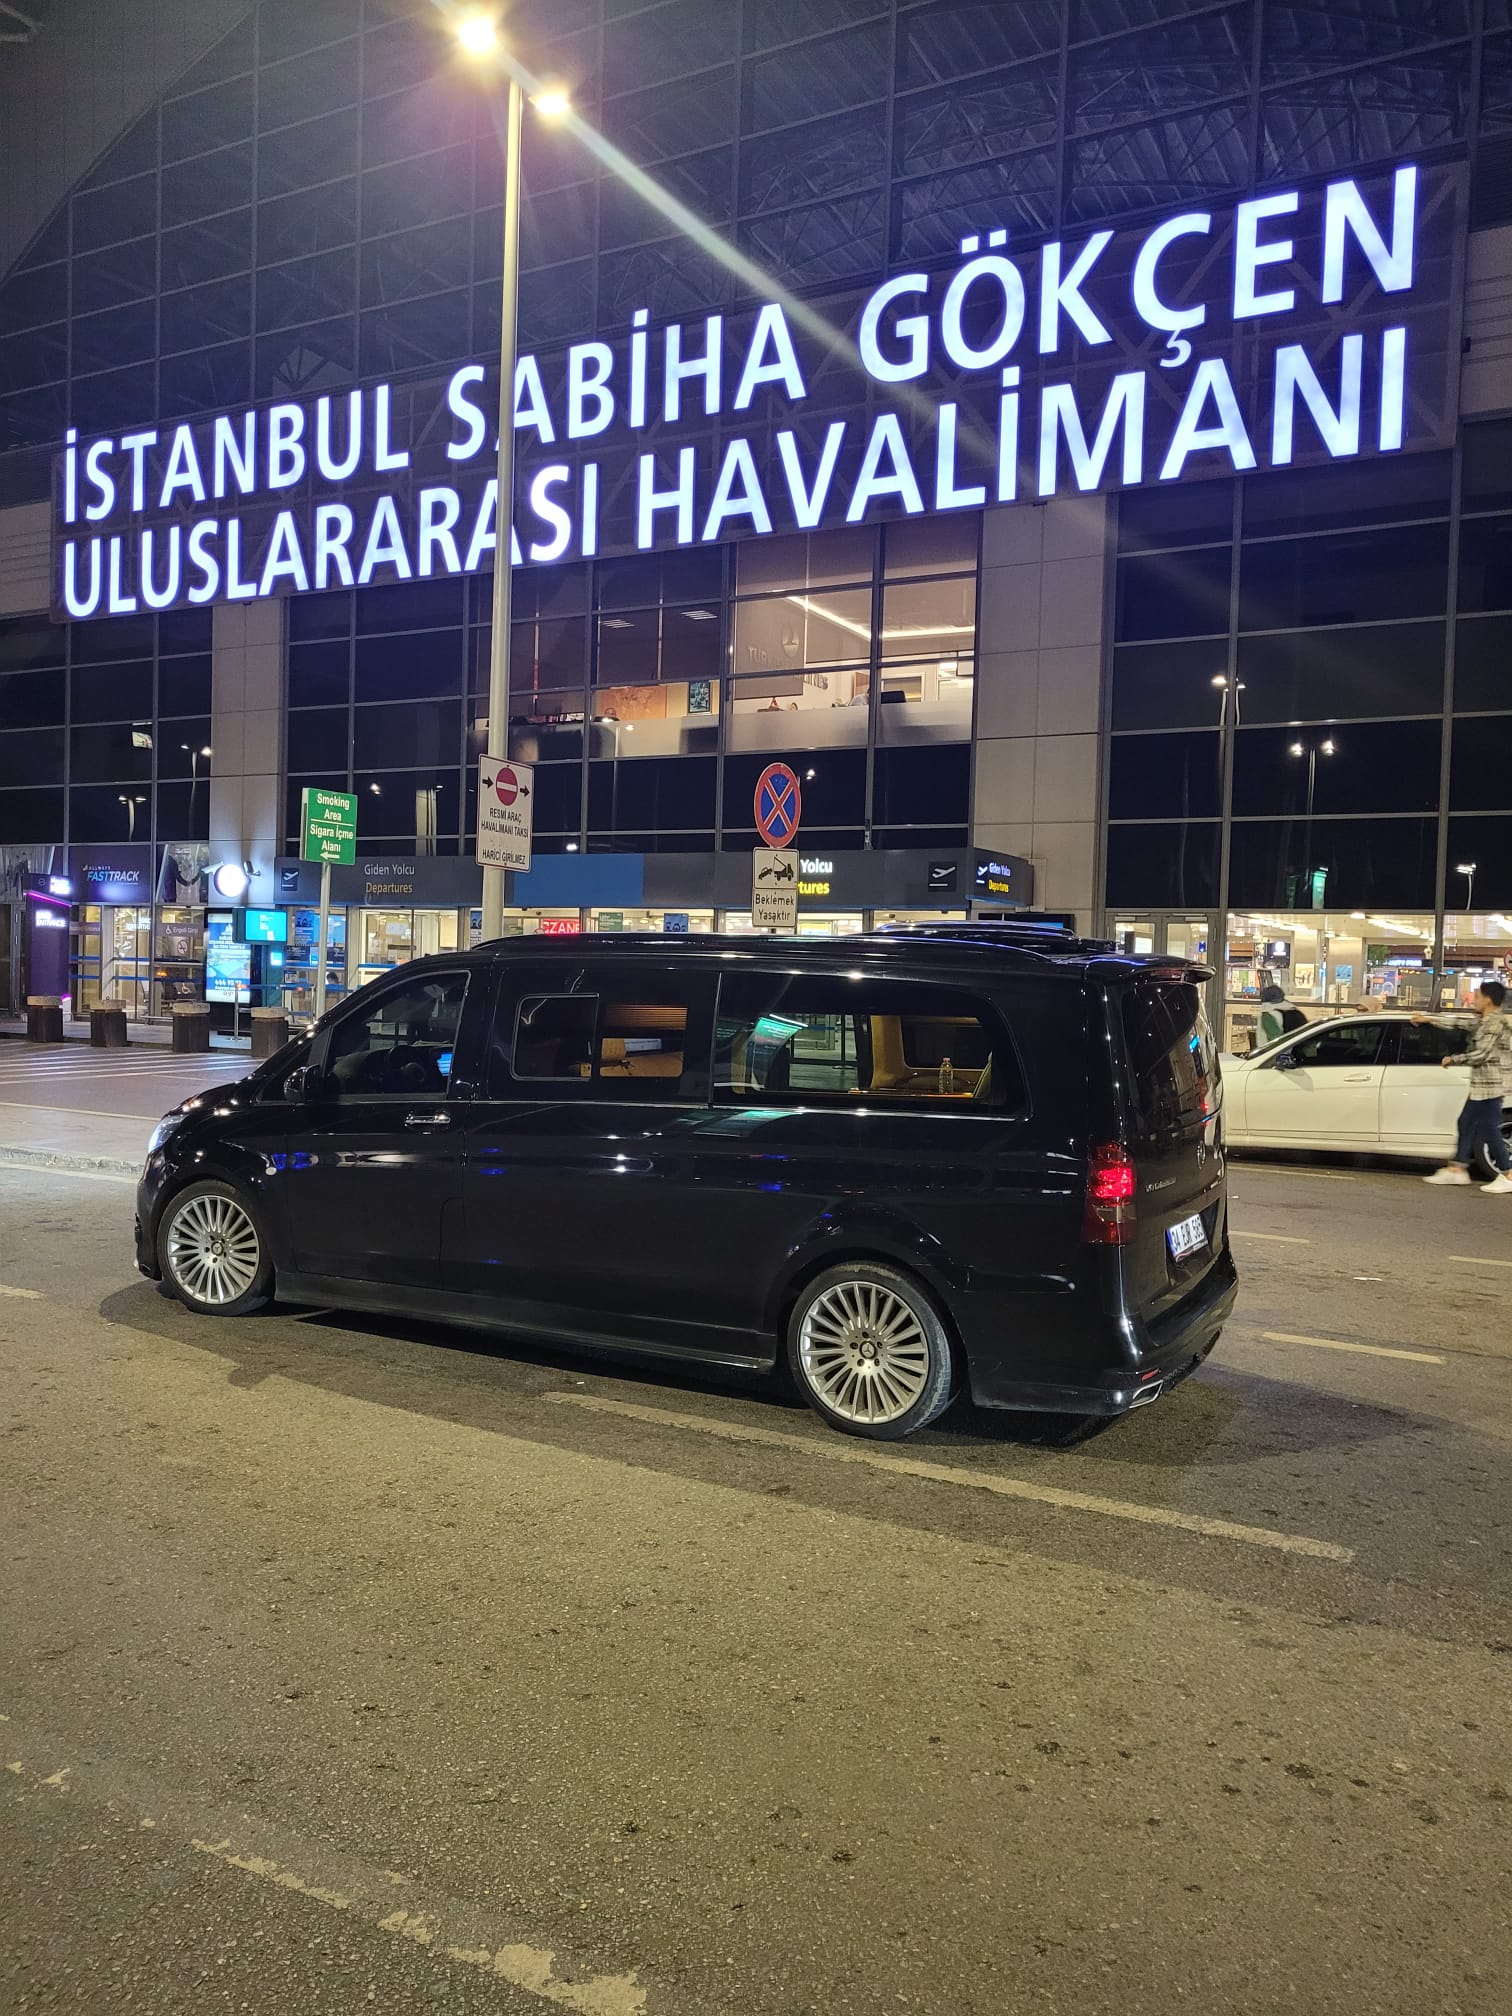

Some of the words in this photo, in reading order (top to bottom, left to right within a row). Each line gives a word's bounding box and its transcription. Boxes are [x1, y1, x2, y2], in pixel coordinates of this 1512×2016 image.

[63, 384, 411, 523] İSTANBUL
[446, 302, 806, 461] SABİHA
[858, 165, 1418, 383] GÖKÇEN
[62, 463, 598, 618] ULUSLARARASI
[637, 327, 1407, 549] HAVALİMANI
[316, 792, 350, 811] Smoking
[324, 808, 342, 822] Area
[489, 807, 507, 820] RESMİ
[507, 809, 522, 824] ARAÇ
[310, 823, 334, 839] Sigara
[335, 824, 354, 840] İçme
[481, 819, 515, 836] HAVALİMANI
[514, 825, 529, 839] TAKSİ
[321, 839, 341, 852] Alanı
[482, 847, 501, 861] HARİCİ
[501, 850, 526, 865] GİRİLMEZ
[364, 864, 390, 875] Giden
[392, 864, 415, 875] Yolcu
[800, 858, 833, 873] Yolcu
[365, 881, 413, 895] Departures
[797, 881, 830, 895] tures
[755, 893, 795, 906] Beklemek
[758, 908, 791, 921] Yasaktır
